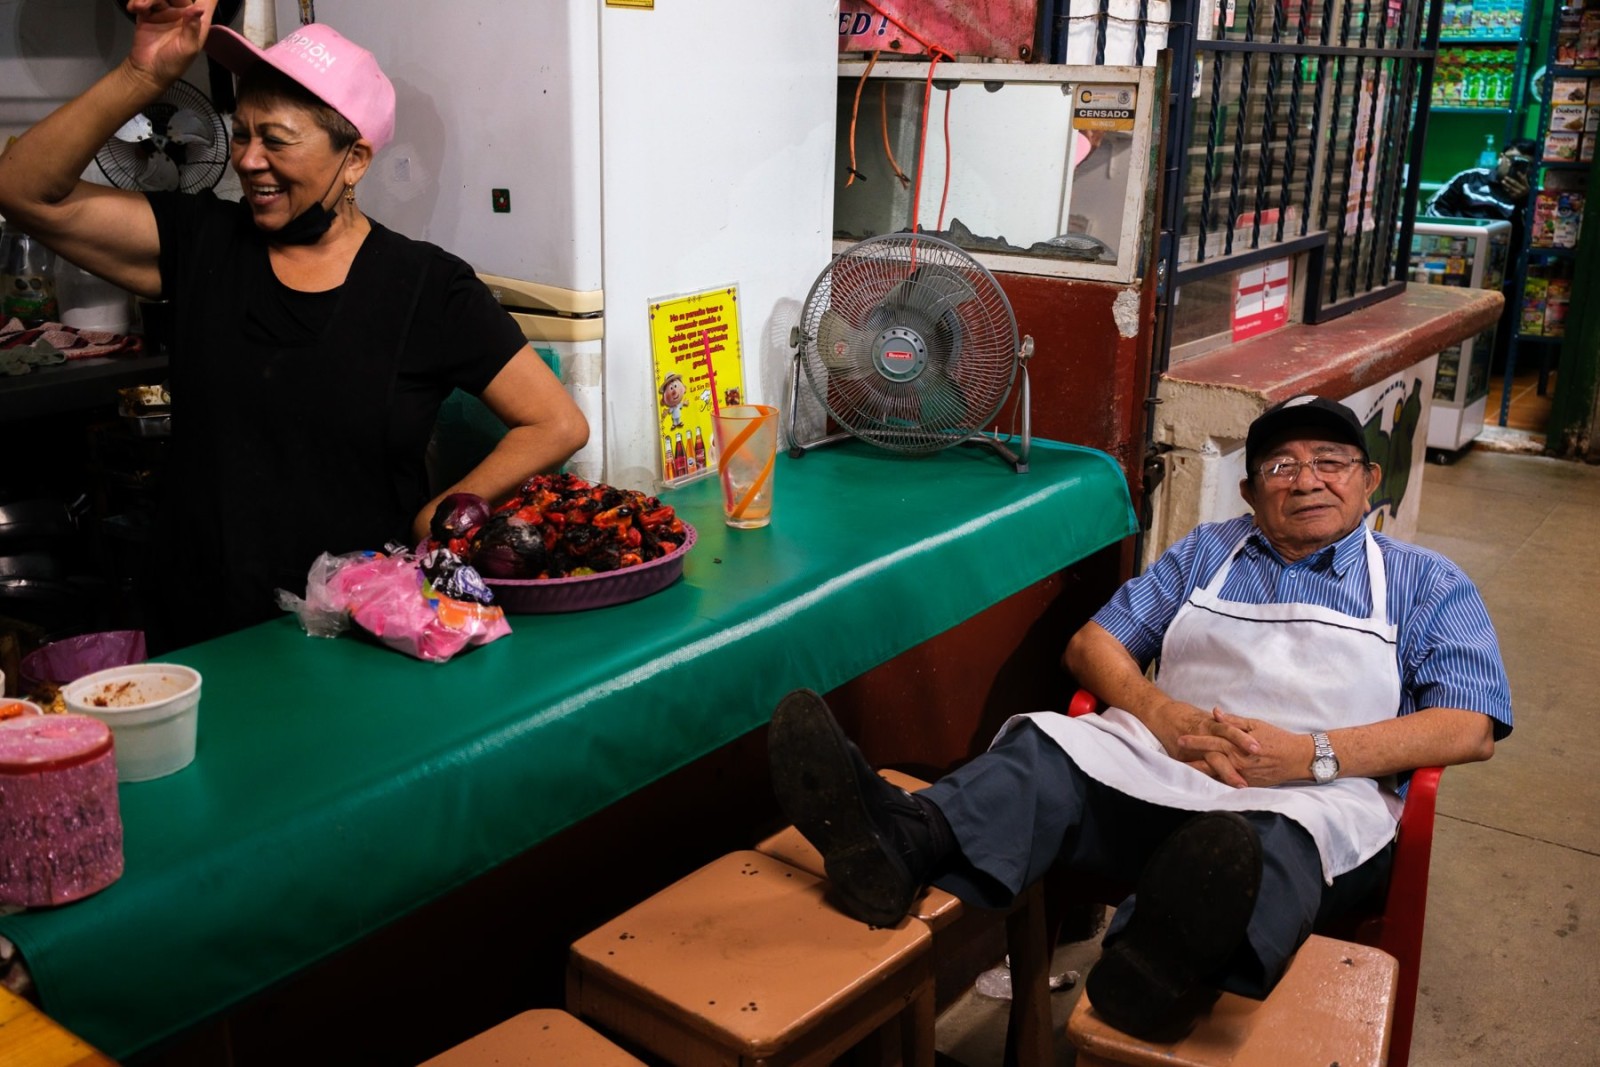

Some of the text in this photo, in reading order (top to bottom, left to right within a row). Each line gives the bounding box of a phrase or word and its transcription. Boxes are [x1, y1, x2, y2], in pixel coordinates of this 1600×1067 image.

[1079, 109, 1129, 118] CENSADO
[670, 314, 679, 322] No
[668, 333, 686, 343] bebida
